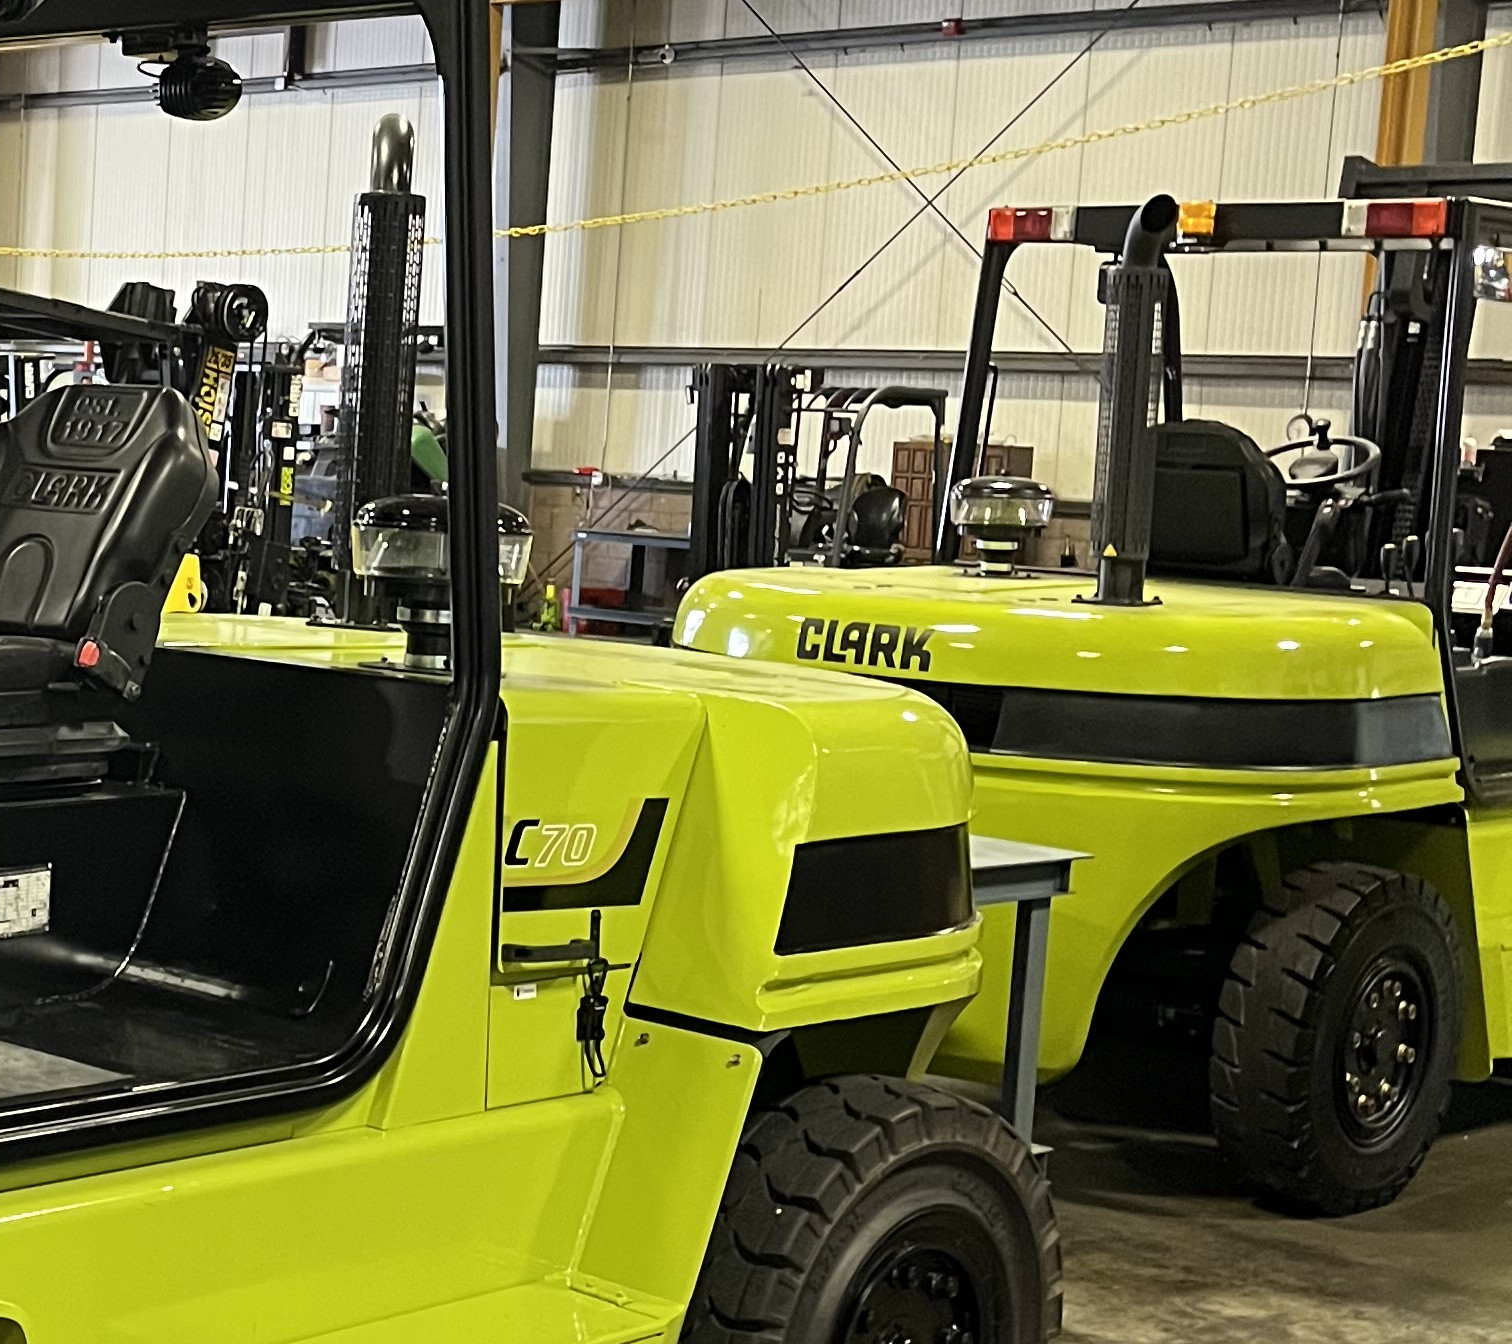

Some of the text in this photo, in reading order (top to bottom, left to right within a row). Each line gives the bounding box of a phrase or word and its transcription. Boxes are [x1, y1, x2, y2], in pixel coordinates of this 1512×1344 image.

[60, 419, 125, 443] 1917
[8, 470, 110, 509] CLARK
[797, 617, 934, 672] CLARK
[504, 819, 598, 867] C70
